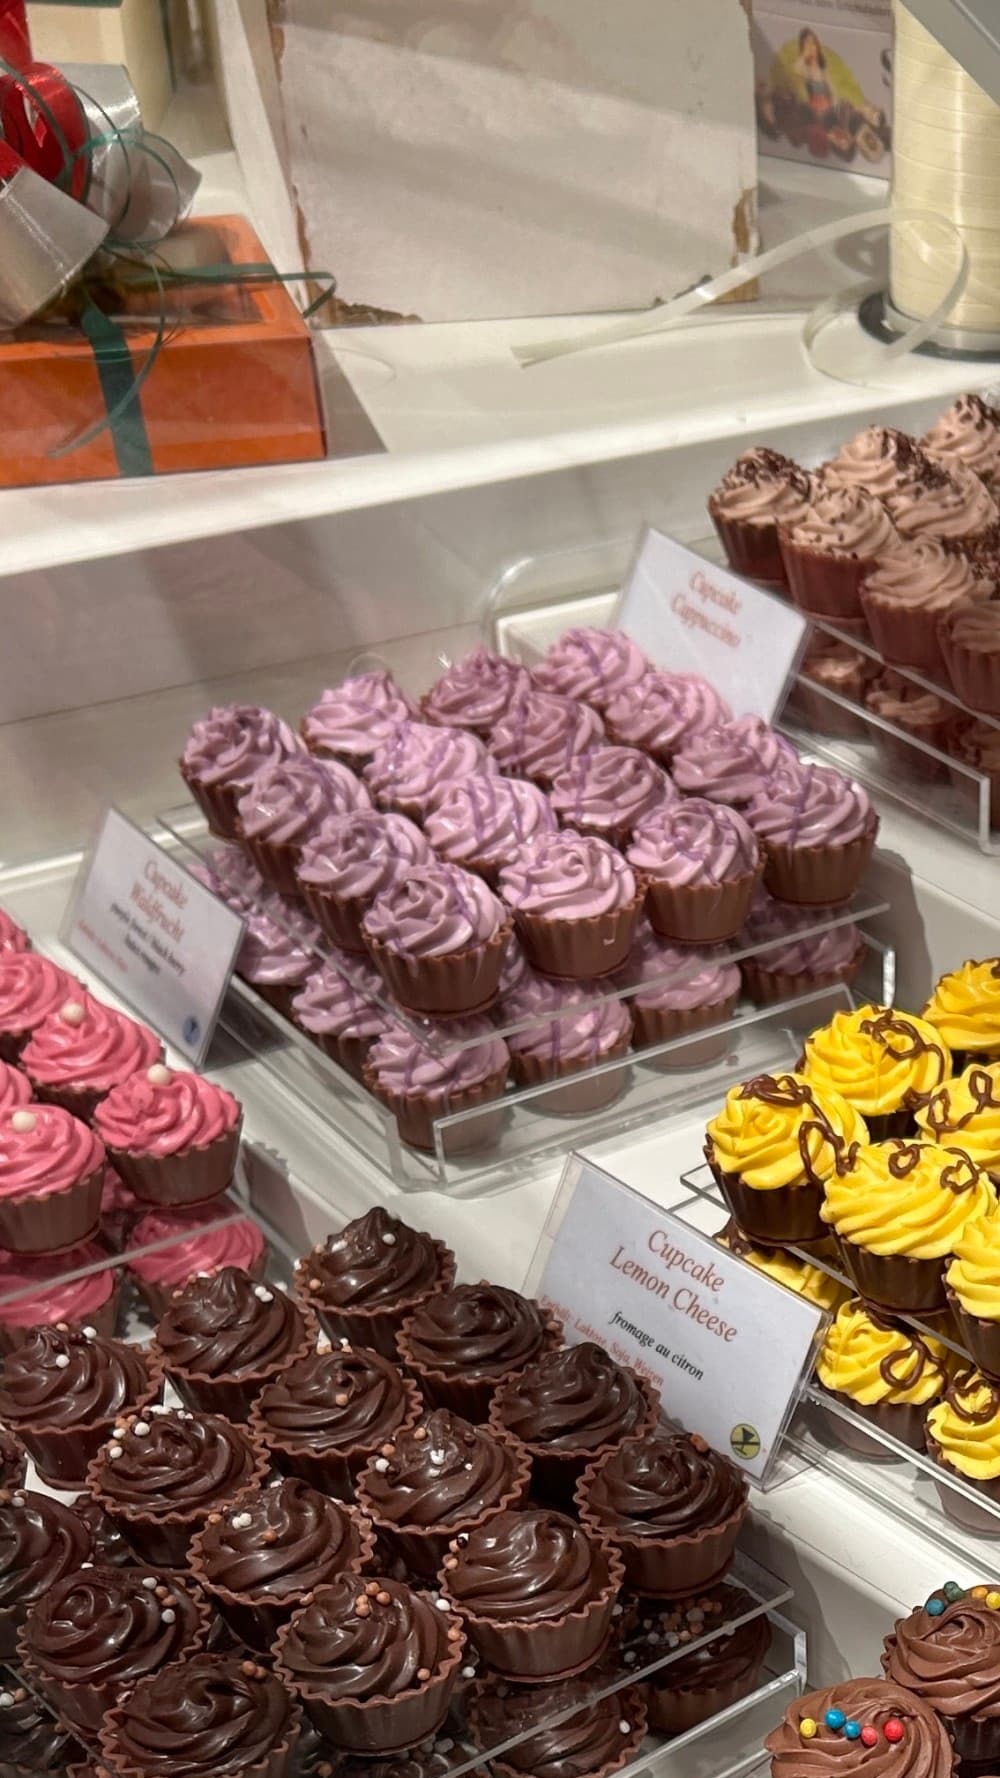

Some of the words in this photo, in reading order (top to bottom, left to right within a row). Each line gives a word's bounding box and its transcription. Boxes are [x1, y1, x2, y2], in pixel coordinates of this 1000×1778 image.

[609, 1246, 671, 1299] Lemon
[673, 1287, 737, 1343] Cheese
[647, 1229, 725, 1293] Cupcake
[608, 1311, 655, 1347] fromage
[655, 1343, 671, 1359] au
[671, 1352, 704, 1380] citron
